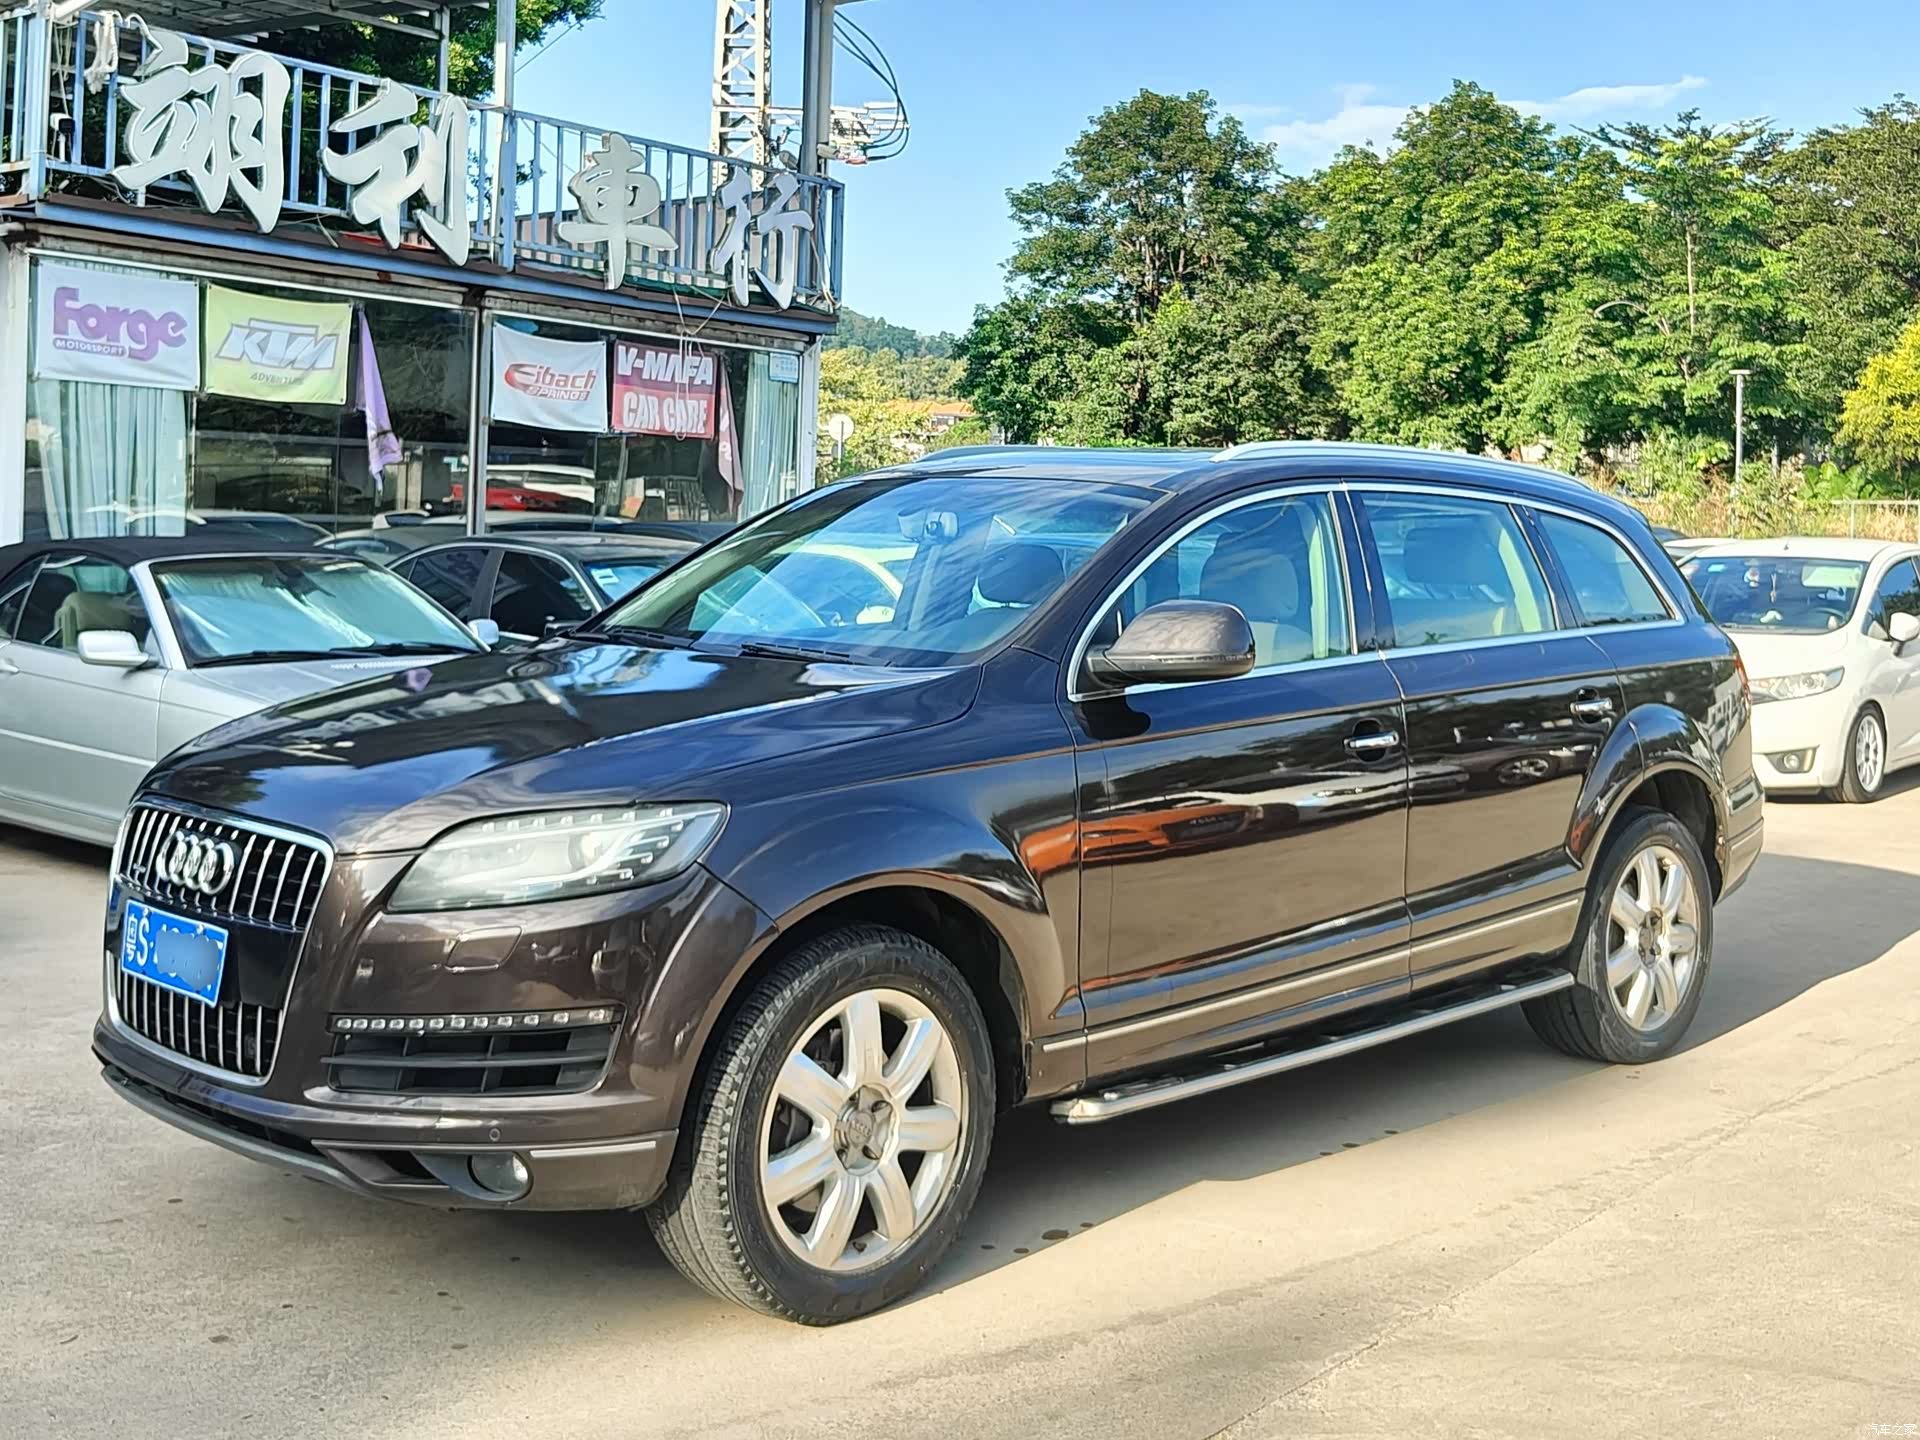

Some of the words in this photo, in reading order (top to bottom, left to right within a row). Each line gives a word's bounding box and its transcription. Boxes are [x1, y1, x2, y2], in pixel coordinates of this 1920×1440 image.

[53, 286, 188, 362] Forge
[55, 339, 125, 357] MOTORSPORT
[215, 317, 340, 371] KTM
[504, 363, 597, 391] Eibach
[526, 385, 590, 401] SPRINGS
[623, 391, 660, 431] CAR
[663, 397, 708, 434] CARE
